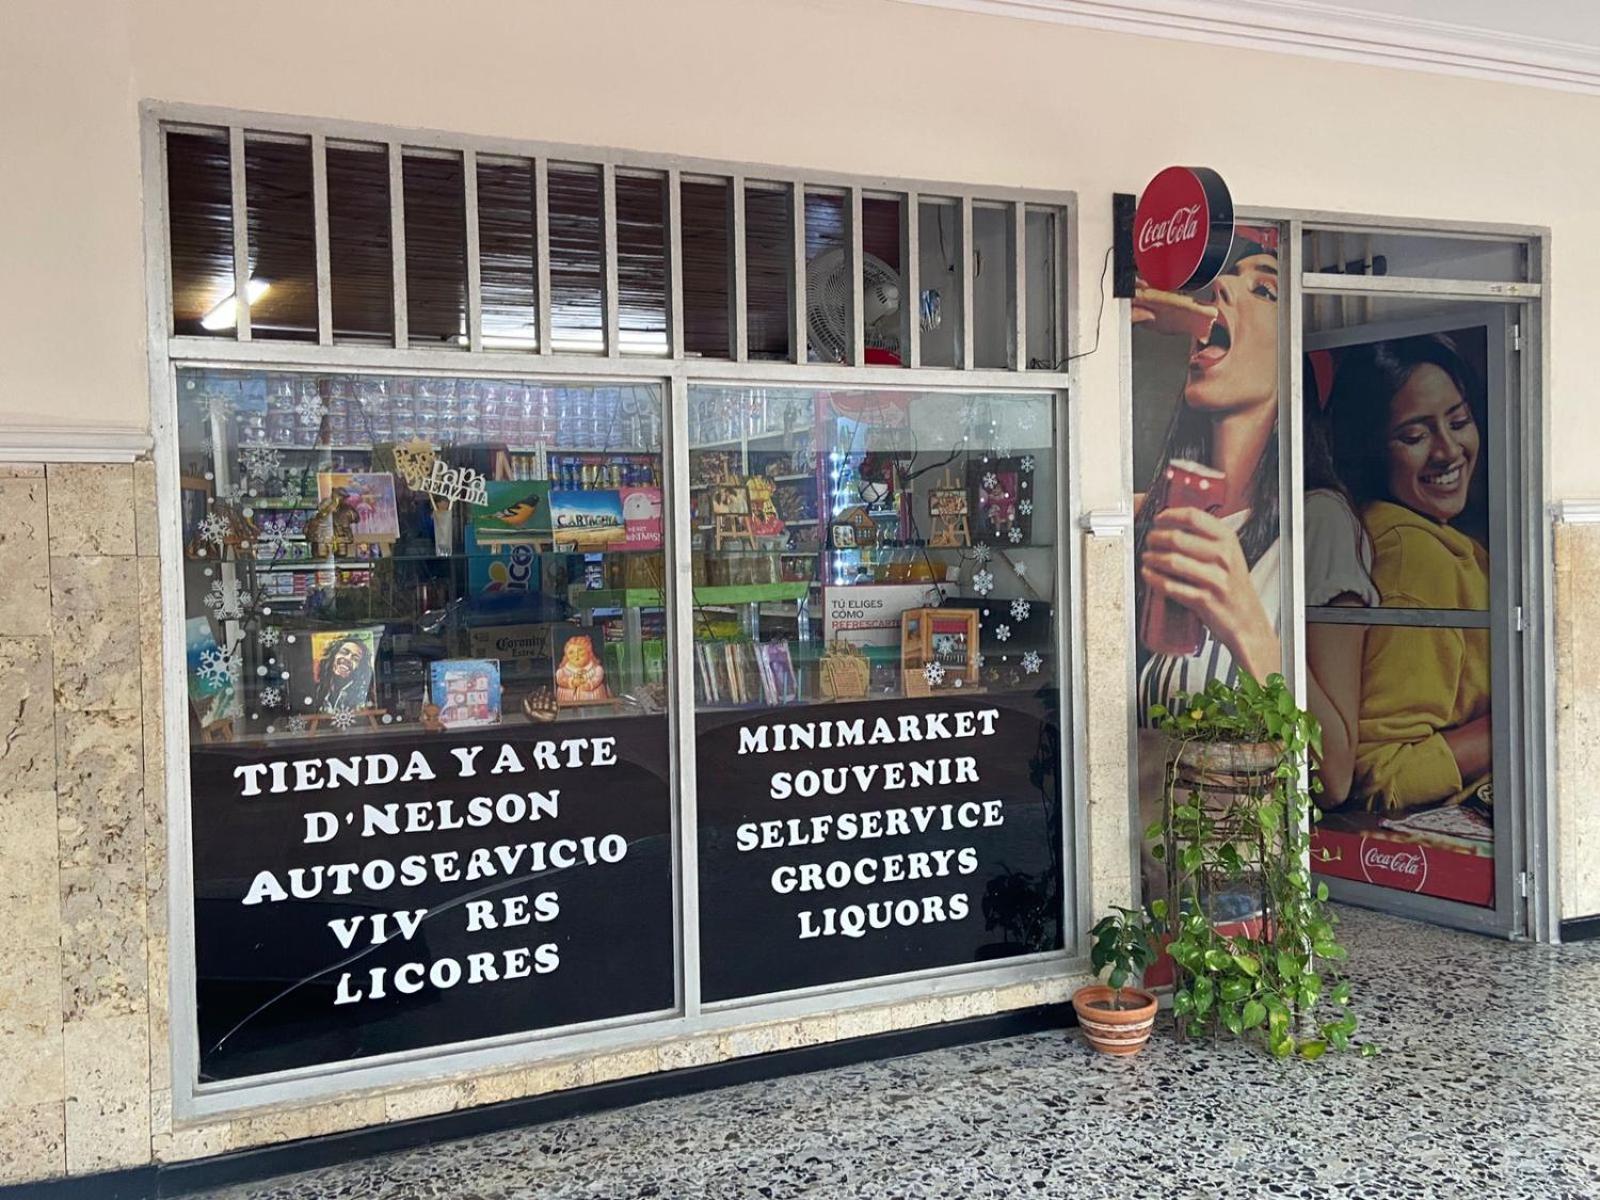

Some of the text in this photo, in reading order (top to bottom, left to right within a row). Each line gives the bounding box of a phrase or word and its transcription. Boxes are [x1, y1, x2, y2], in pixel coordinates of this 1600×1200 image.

[1138, 204, 1201, 252] Coca-Cola
[832, 599, 883, 609] TÚ ELIGES
[832, 609, 865, 619] CÓMO
[737, 708, 1000, 755] MINIMARKET
[233, 736, 618, 796] TIENDA Y ARTE
[770, 756, 980, 800] SOUVENIR
[303, 789, 561, 844] D'NELSON
[736, 799, 1004, 852] SELFSERVICE
[241, 833, 628, 905] AUTOSERVICIO
[771, 847, 978, 894] GROCERYS
[1364, 847, 1421, 876] Coca-Cola
[797, 893, 969, 939] LIQUORS
[333, 942, 560, 1005] LICORES
